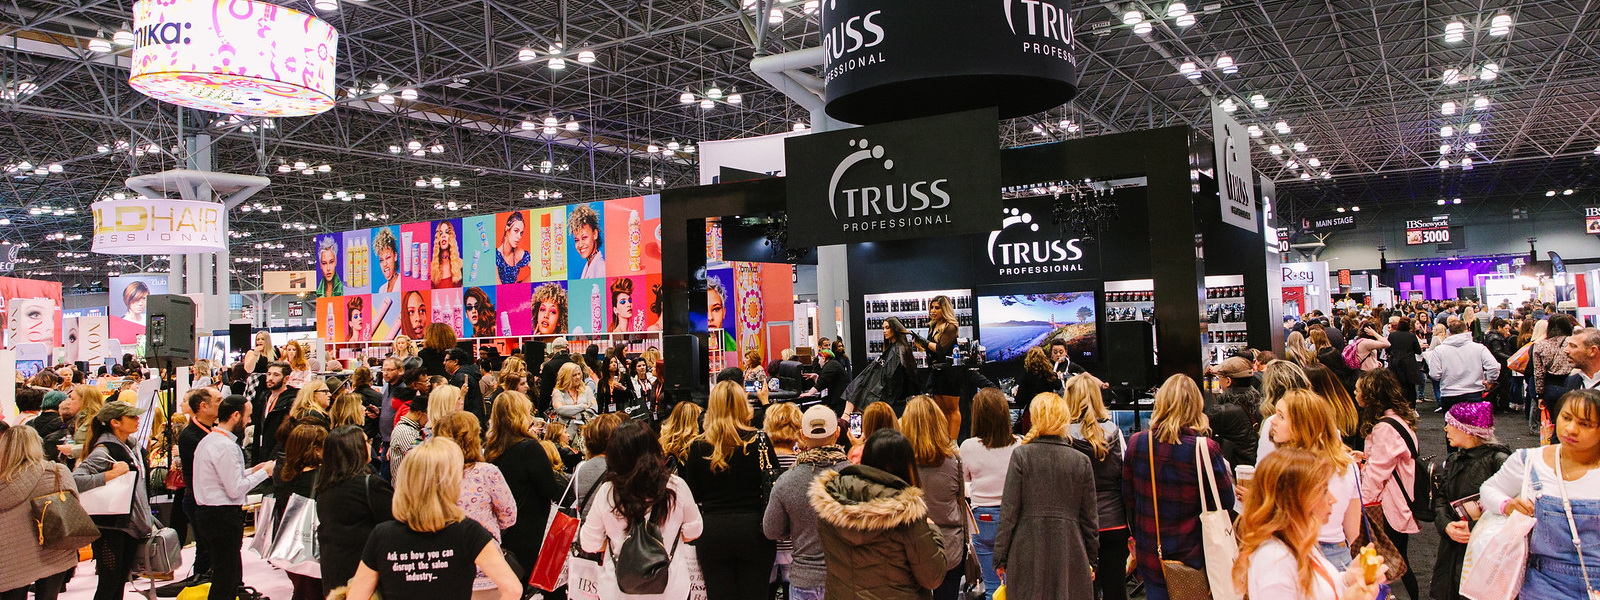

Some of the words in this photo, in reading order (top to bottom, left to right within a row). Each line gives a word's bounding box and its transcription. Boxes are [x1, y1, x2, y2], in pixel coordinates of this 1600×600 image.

[842, 179, 951, 218] TRUSS
[843, 214, 951, 232] PROFESSIONAL
[1316, 219, 1333, 228] MAIN
[1333, 216, 1354, 225] STAGE
[1423, 230, 1450, 243] 3000
[998, 238, 1083, 265] TRUSS
[999, 264, 1084, 275] PROFESSIONAL
[387, 551, 398, 561] Ask
[400, 553, 408, 561] us
[410, 550, 425, 560] how
[427, 551, 440, 561] you
[442, 549, 454, 558] can
[392, 562, 416, 573] disrupt
[418, 560, 429, 570] the
[431, 559, 449, 569] salon
[578, 577, 599, 594] IBS
